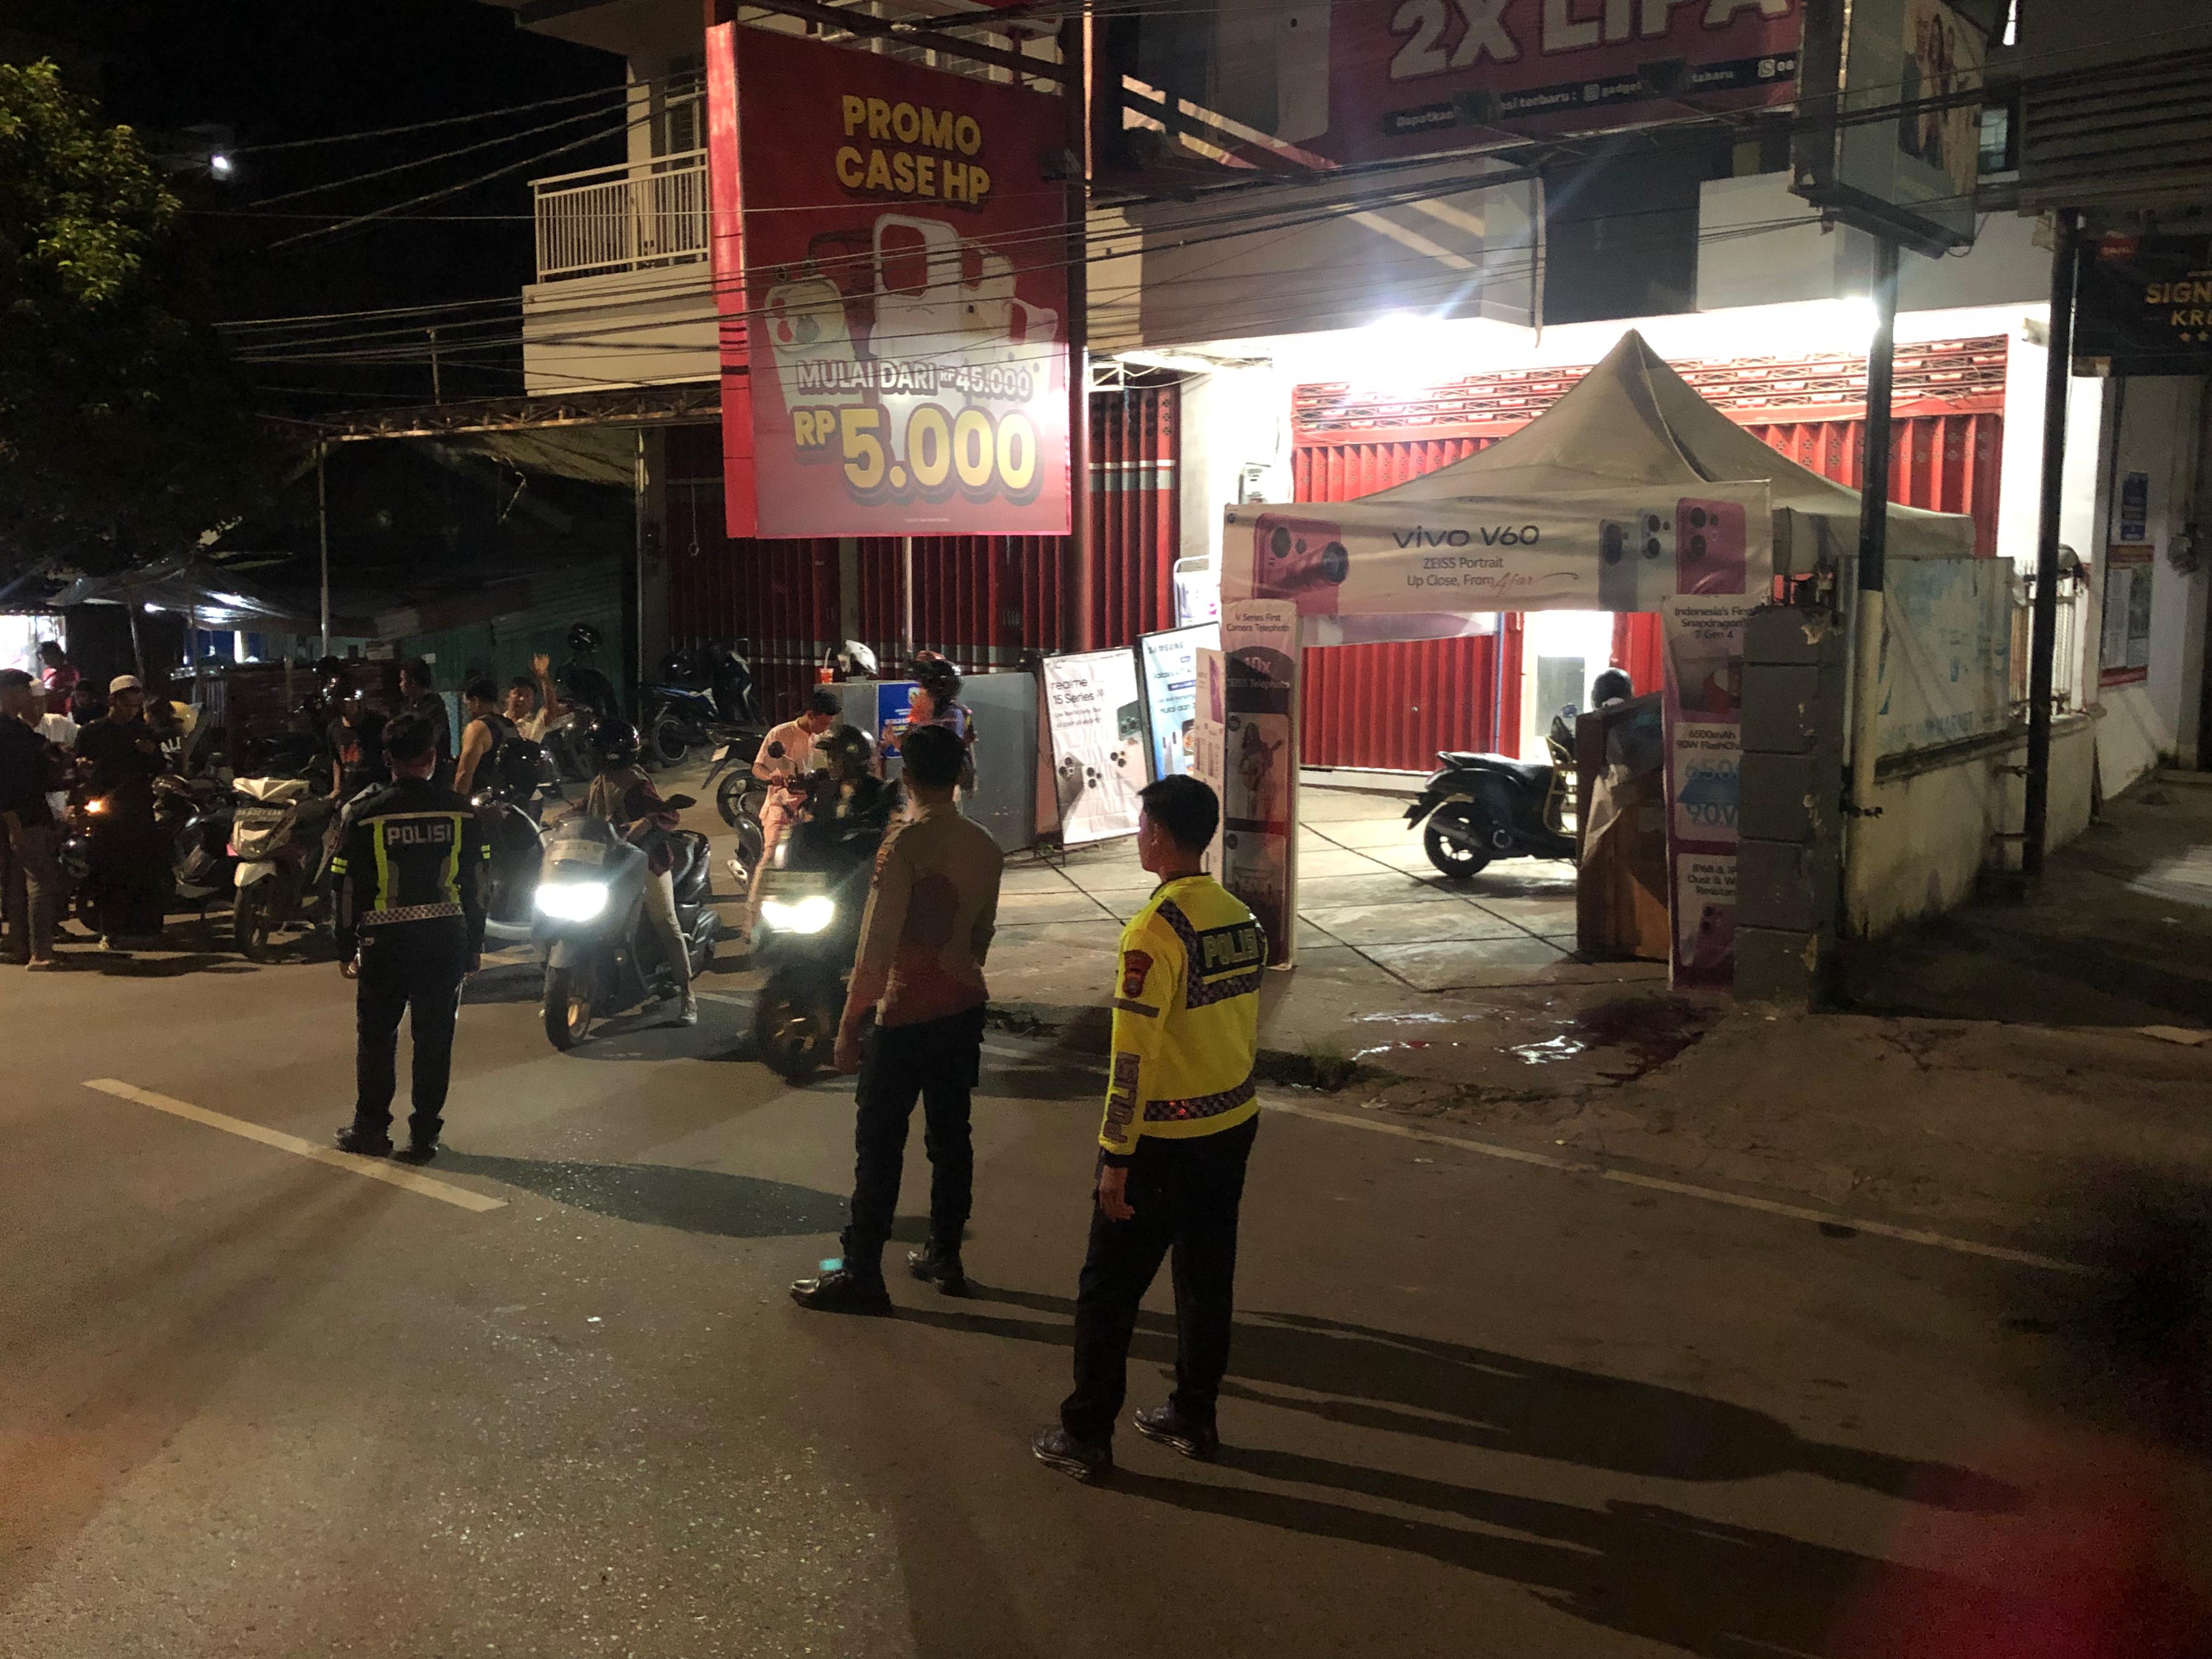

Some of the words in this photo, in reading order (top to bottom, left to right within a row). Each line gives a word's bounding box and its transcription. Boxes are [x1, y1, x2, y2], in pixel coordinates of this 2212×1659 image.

[1390, 0, 1520, 79] 2X
[842, 94, 981, 156] PROMO
[836, 145, 936, 196] CASE
[943, 160, 991, 205] HP
[797, 359, 874, 389] MULAI
[880, 362, 935, 391] DARI
[1392, 525, 1470, 548] vivo
[1480, 525, 1539, 546] V60
[1423, 557, 1456, 569] ZEISS
[1459, 557, 1504, 569] Portrait
[1407, 575, 1424, 588] Up
[1427, 574, 1460, 587] Close,
[1463, 573, 1494, 586] From
[1243, 613, 1264, 622] Series
[1265, 613, 1281, 622] First
[1674, 606, 1729, 616] Indonesia's
[1226, 623, 1253, 632] Camera
[1254, 623, 1291, 633] Telephoto
[1703, 629, 1724, 639] Gen
[1726, 630, 1734, 639] 4
[1051, 679, 1088, 691] realme
[1064, 691, 1095, 704] Series
[1688, 729, 1736, 739] 6500mAh
[386, 823, 452, 846] POLISI
[1202, 927, 1260, 969] POLISI
[1103, 1052, 1141, 1144] POLISI
